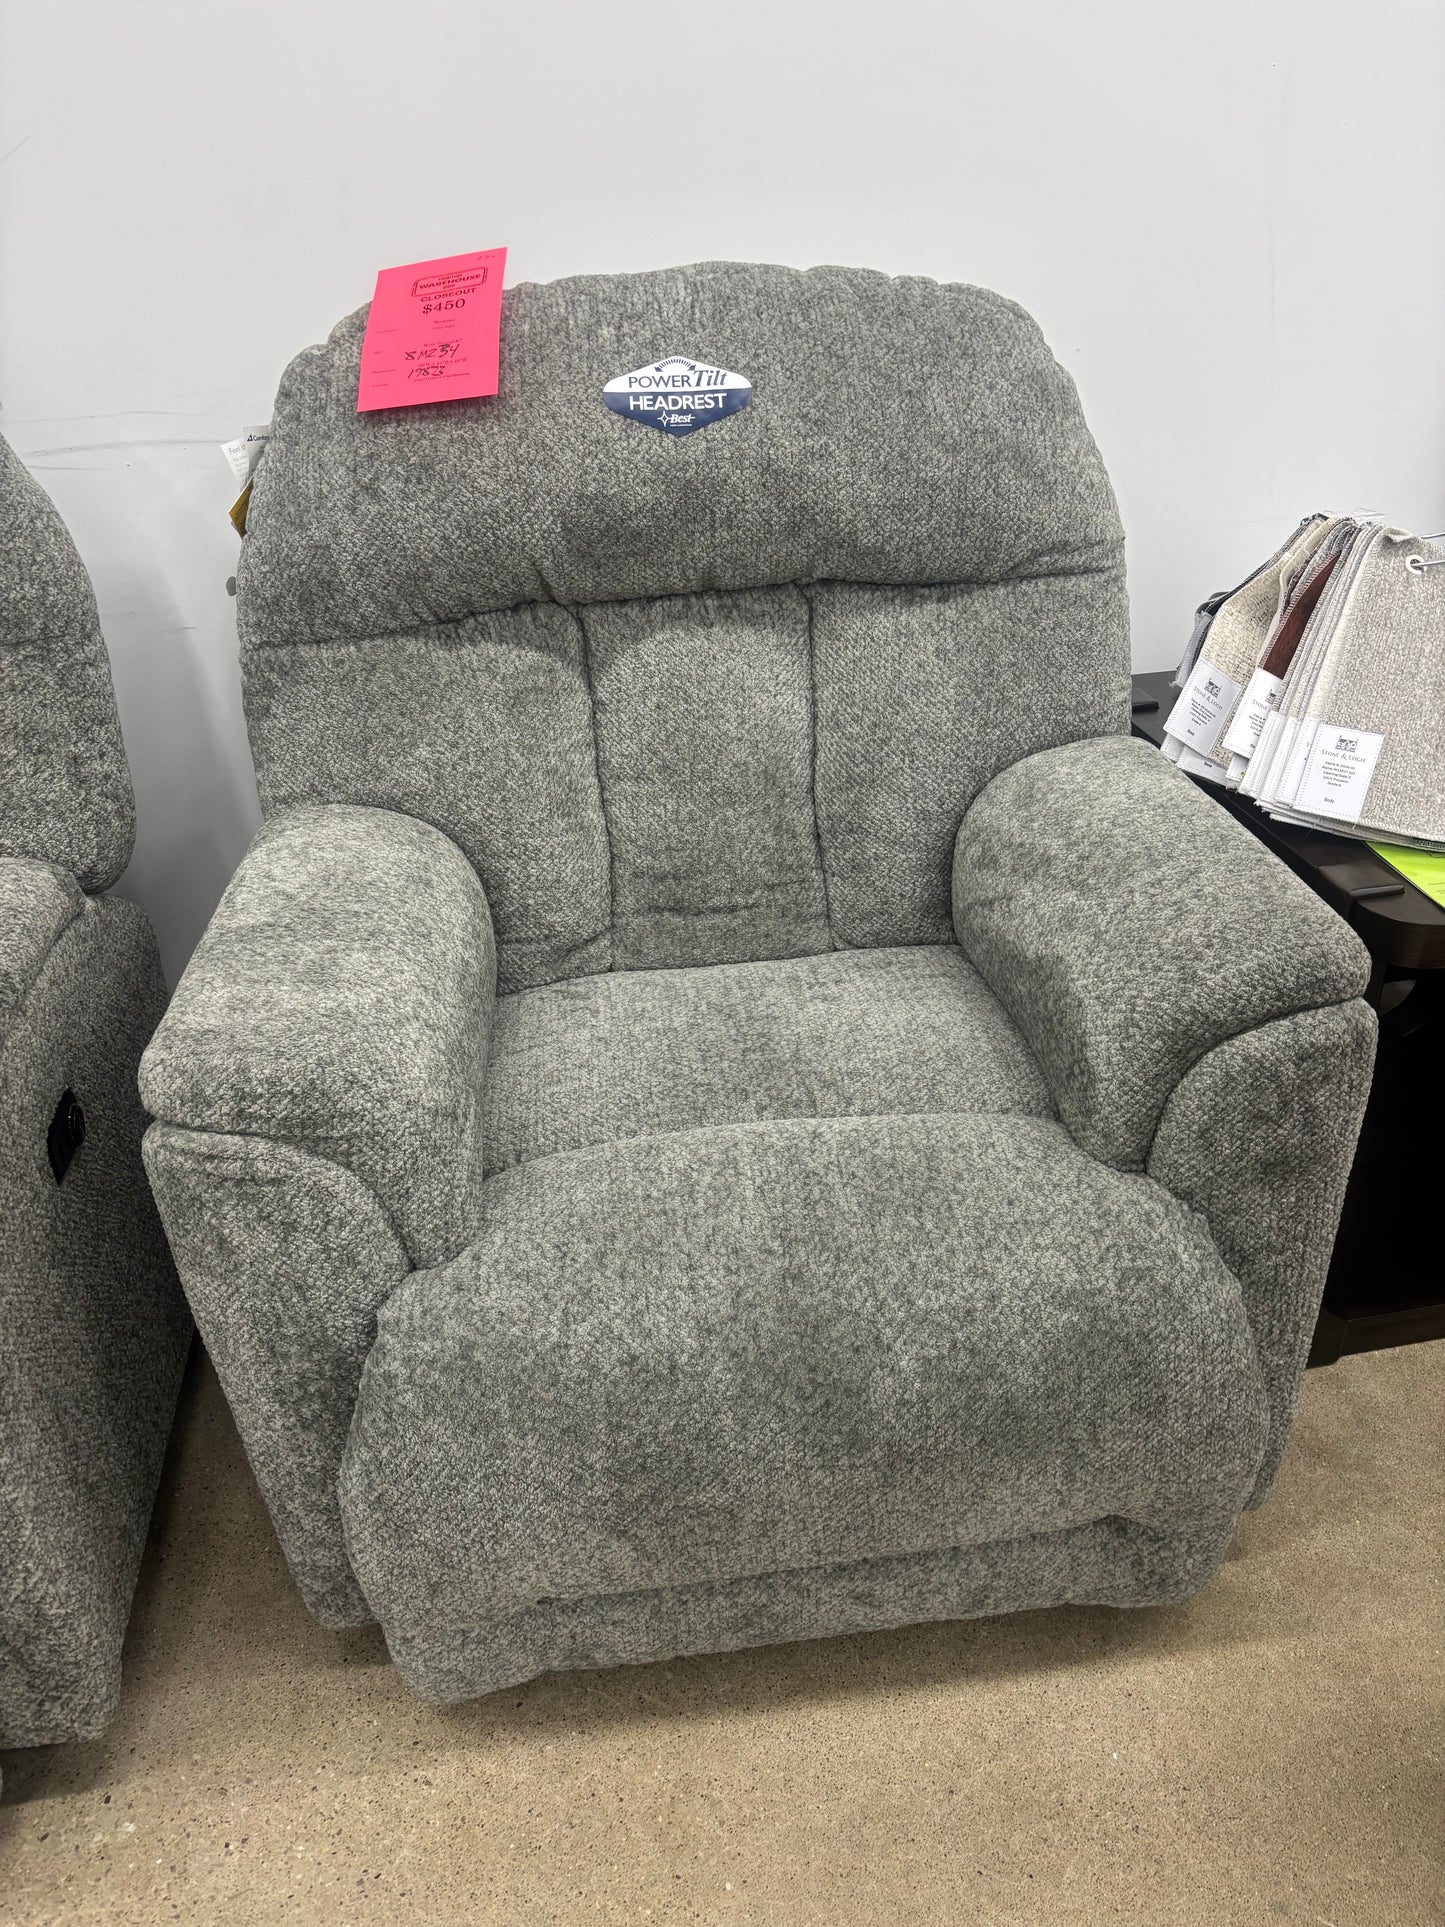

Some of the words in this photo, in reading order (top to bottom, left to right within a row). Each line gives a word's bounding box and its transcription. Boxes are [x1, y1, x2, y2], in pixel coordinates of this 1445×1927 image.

[419, 273, 481, 289] WAREHOUSE
[420, 287, 477, 302] CLOSEOUT
[422, 298, 466, 315] $450
[628, 375, 691, 388] POWER
[693, 370, 728, 388] Tilt
[629, 393, 728, 411] HEADREST
[669, 413, 692, 424] Best
[1321, 749, 1340, 758] STONE
[1348, 754, 1366, 763] LEIGH
